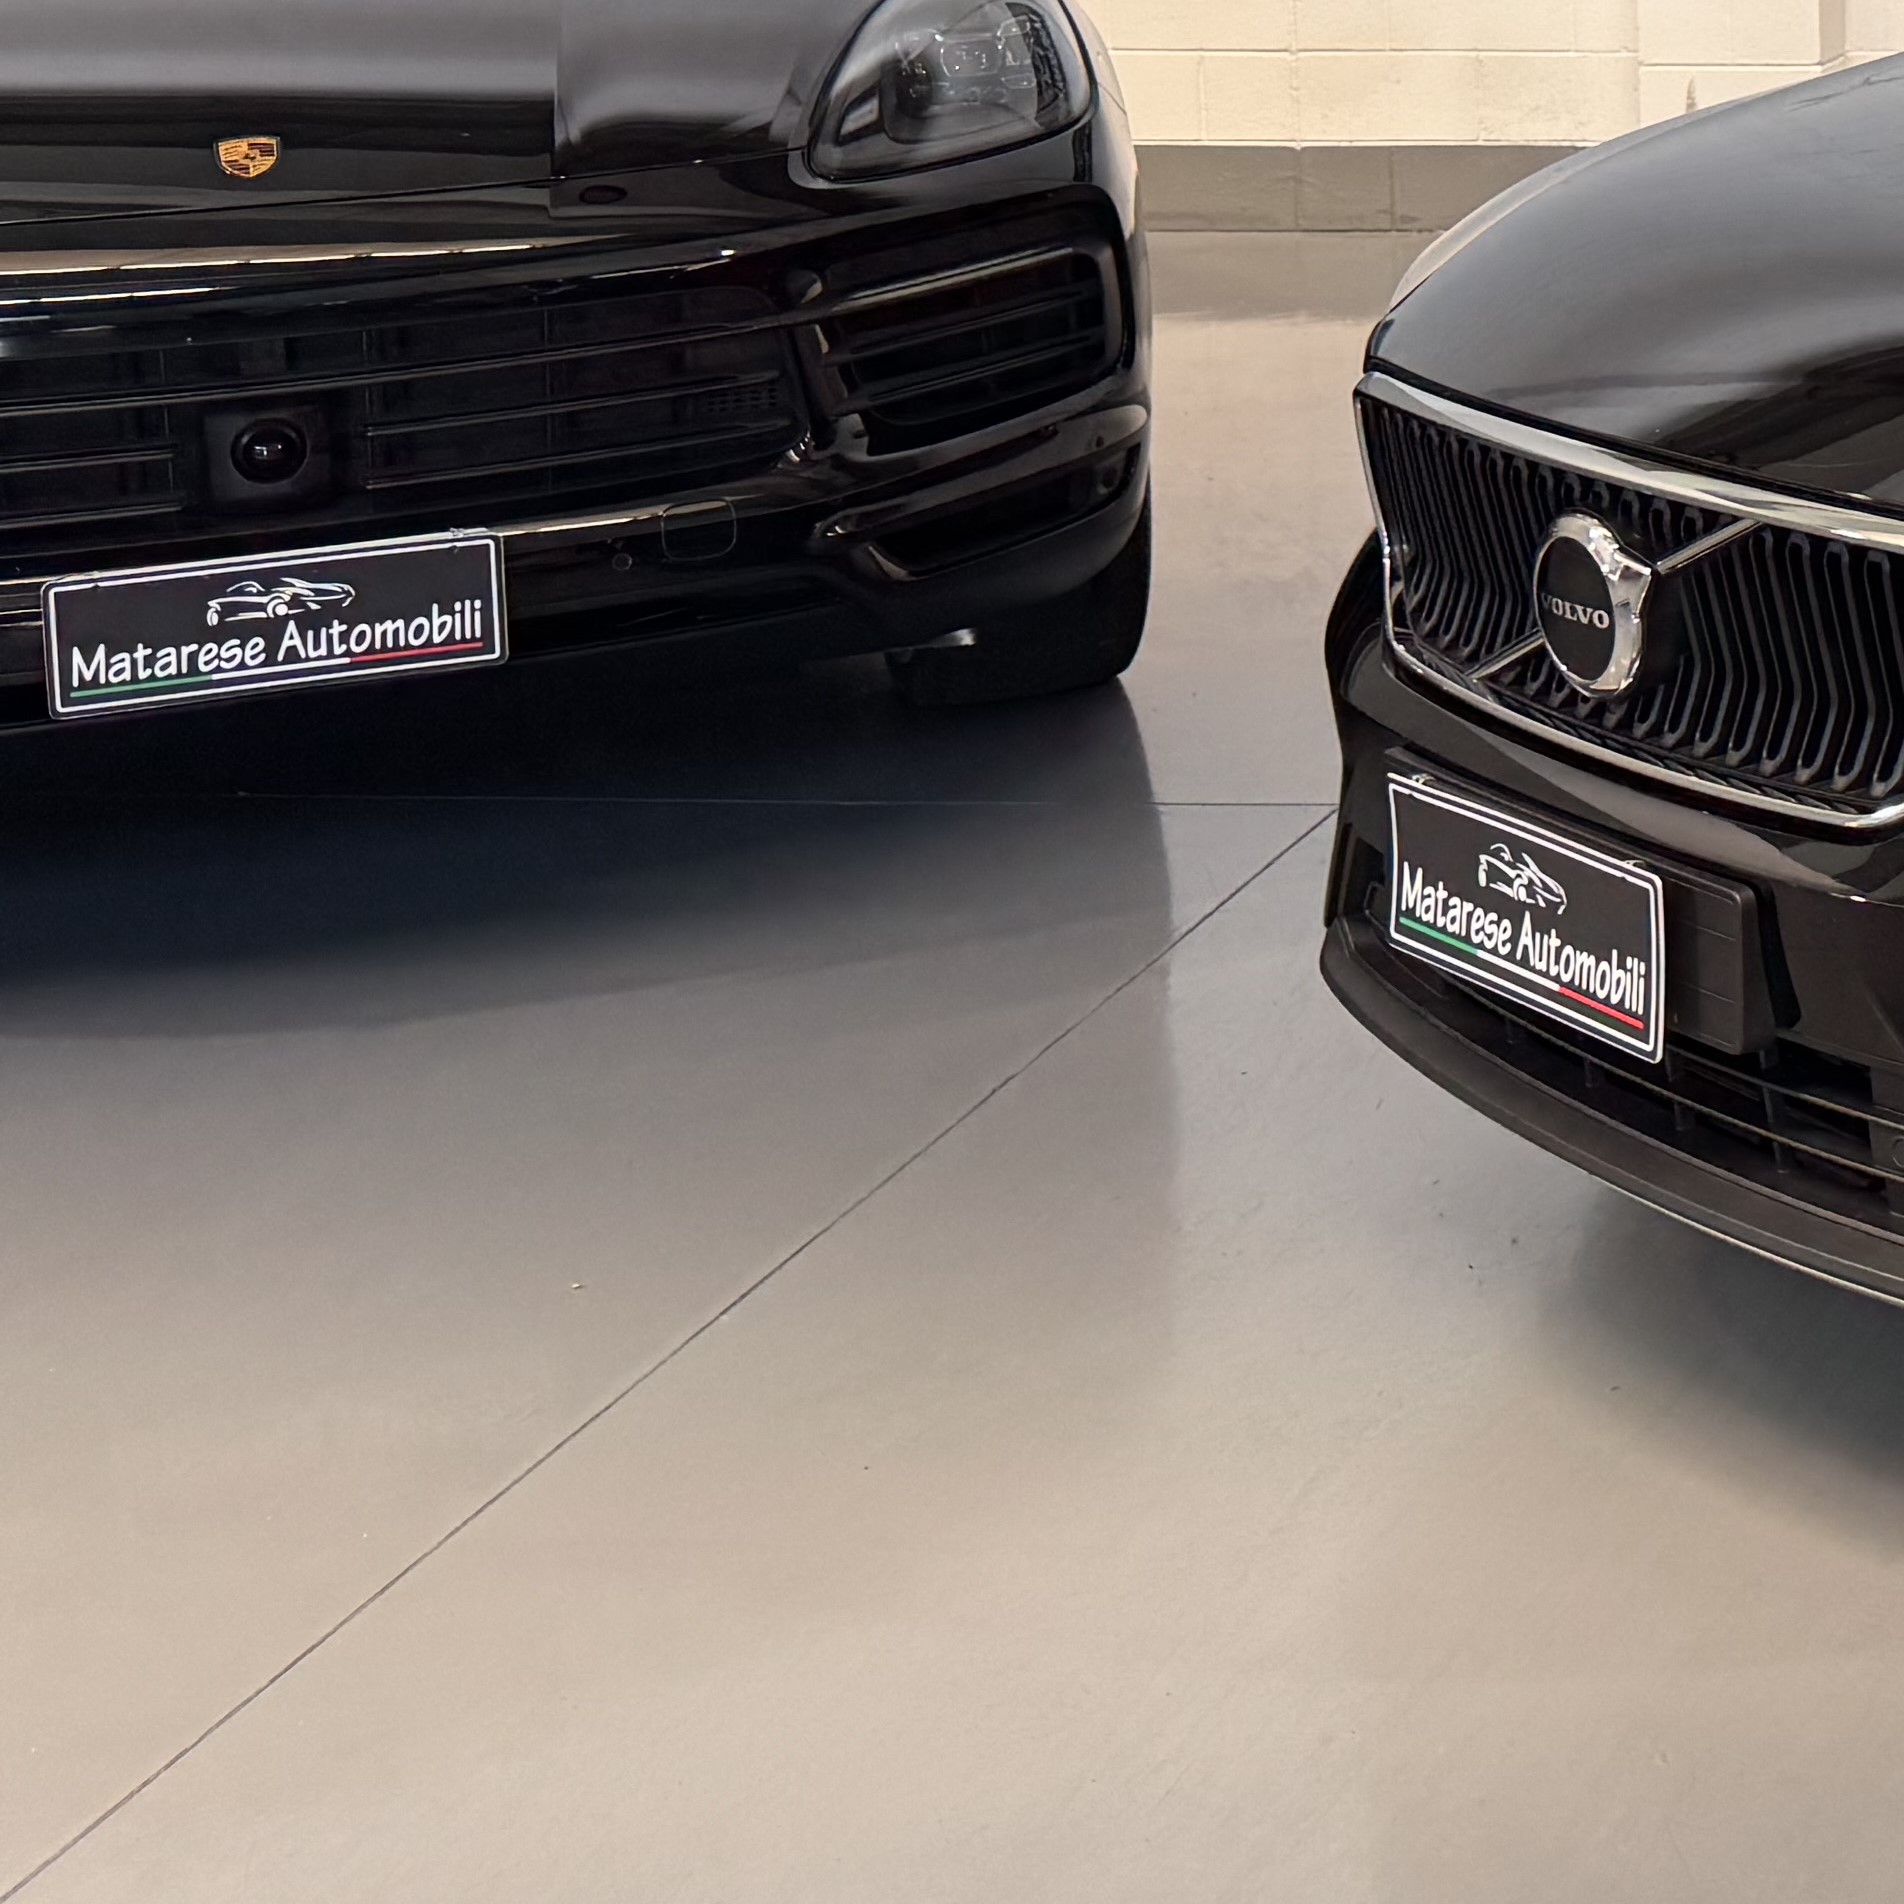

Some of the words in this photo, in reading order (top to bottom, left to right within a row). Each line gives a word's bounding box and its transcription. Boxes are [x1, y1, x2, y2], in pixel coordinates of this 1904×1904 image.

[72, 643, 265, 688] Matarese
[277, 599, 482, 661] Automobili
[1541, 592, 1609, 628] VOLVO
[1401, 861, 1511, 956] Matarese
[1516, 911, 1646, 1015] Automobili
